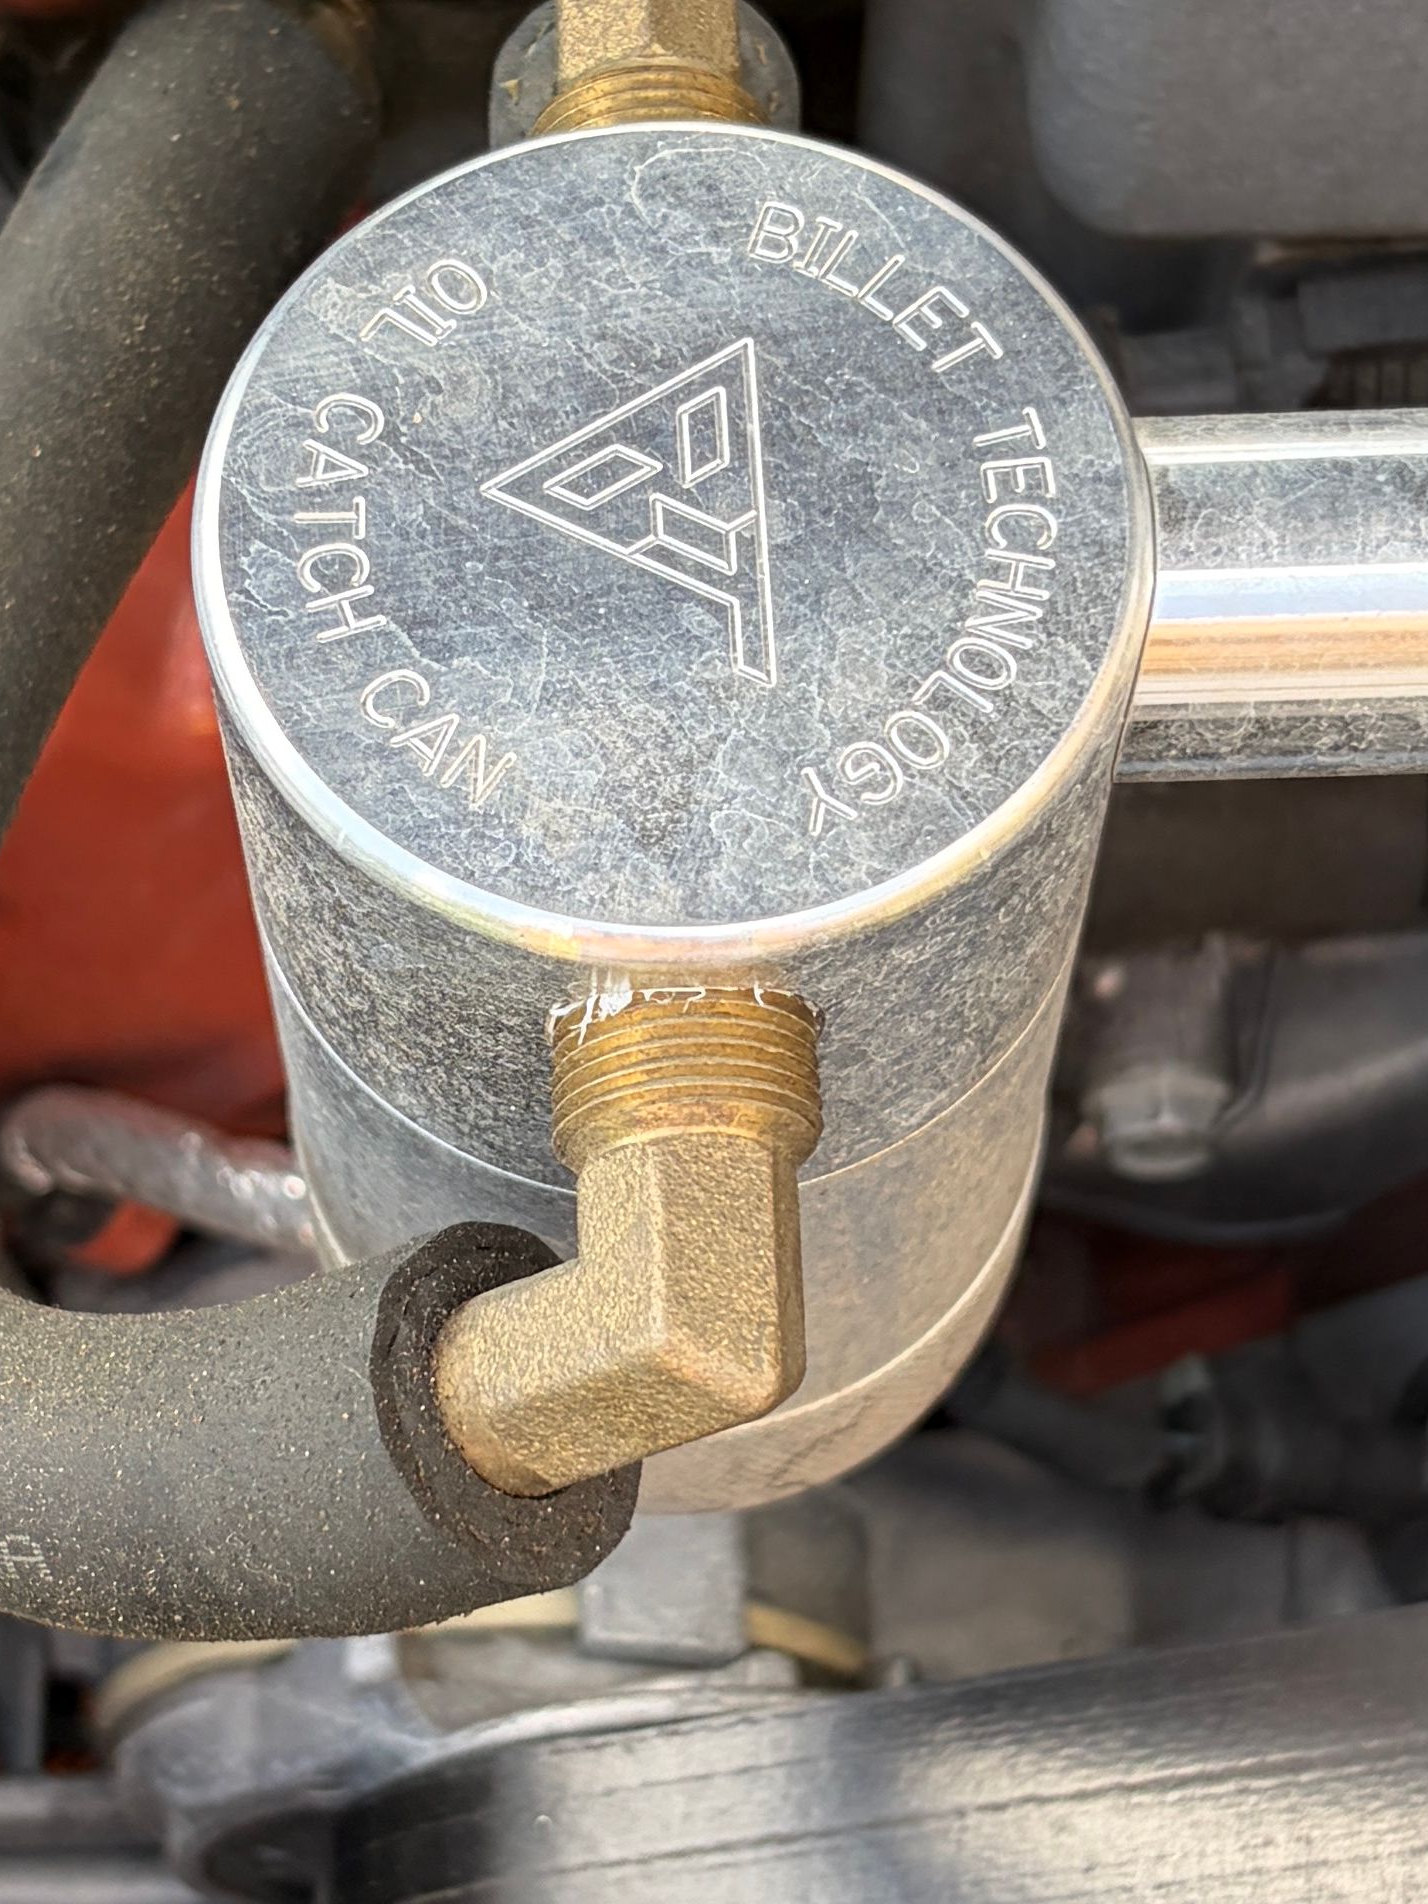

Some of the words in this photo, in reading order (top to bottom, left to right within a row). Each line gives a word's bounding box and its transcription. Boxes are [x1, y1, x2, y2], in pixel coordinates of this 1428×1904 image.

[358, 258, 488, 347] OIL
[747, 200, 1003, 374] BILLET
[292, 393, 388, 644] CATCH
[800, 406, 1059, 837] TECHNOLOGY
[360, 668, 518, 811] CAN
